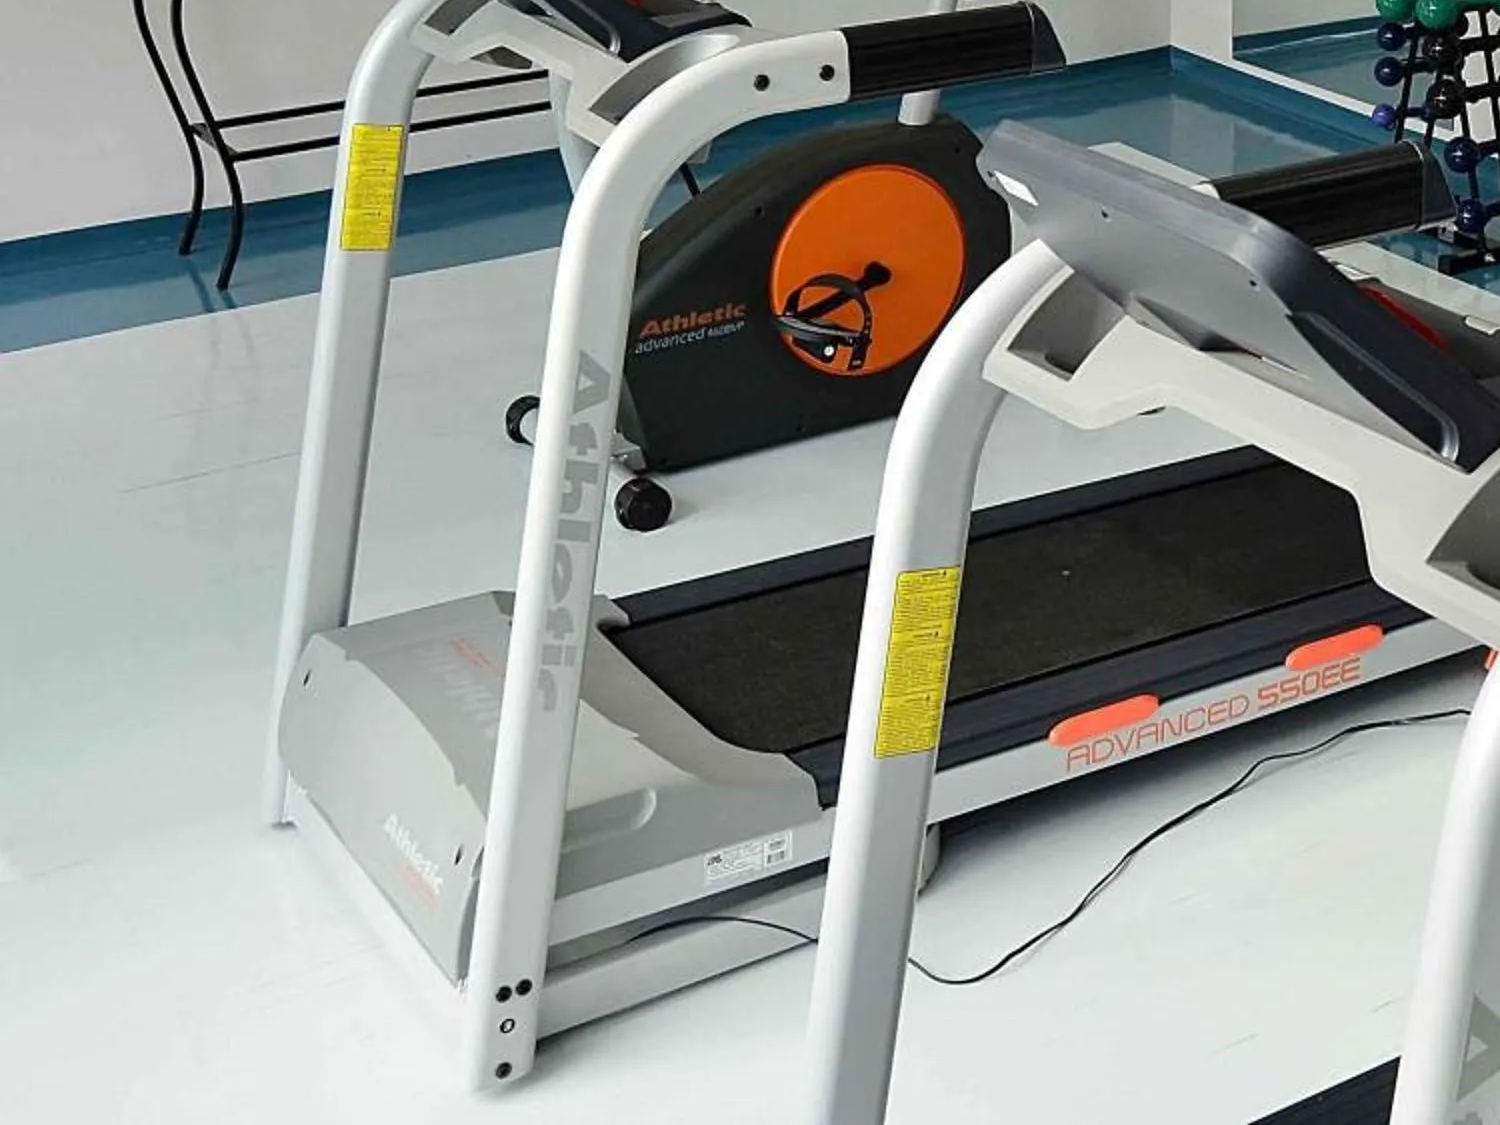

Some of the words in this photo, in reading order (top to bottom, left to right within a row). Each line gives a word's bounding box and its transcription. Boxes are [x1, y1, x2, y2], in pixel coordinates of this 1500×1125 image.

[639, 302, 748, 338] Athletic
[634, 327, 706, 354] advanced
[1066, 694, 1251, 773] ADVANCED
